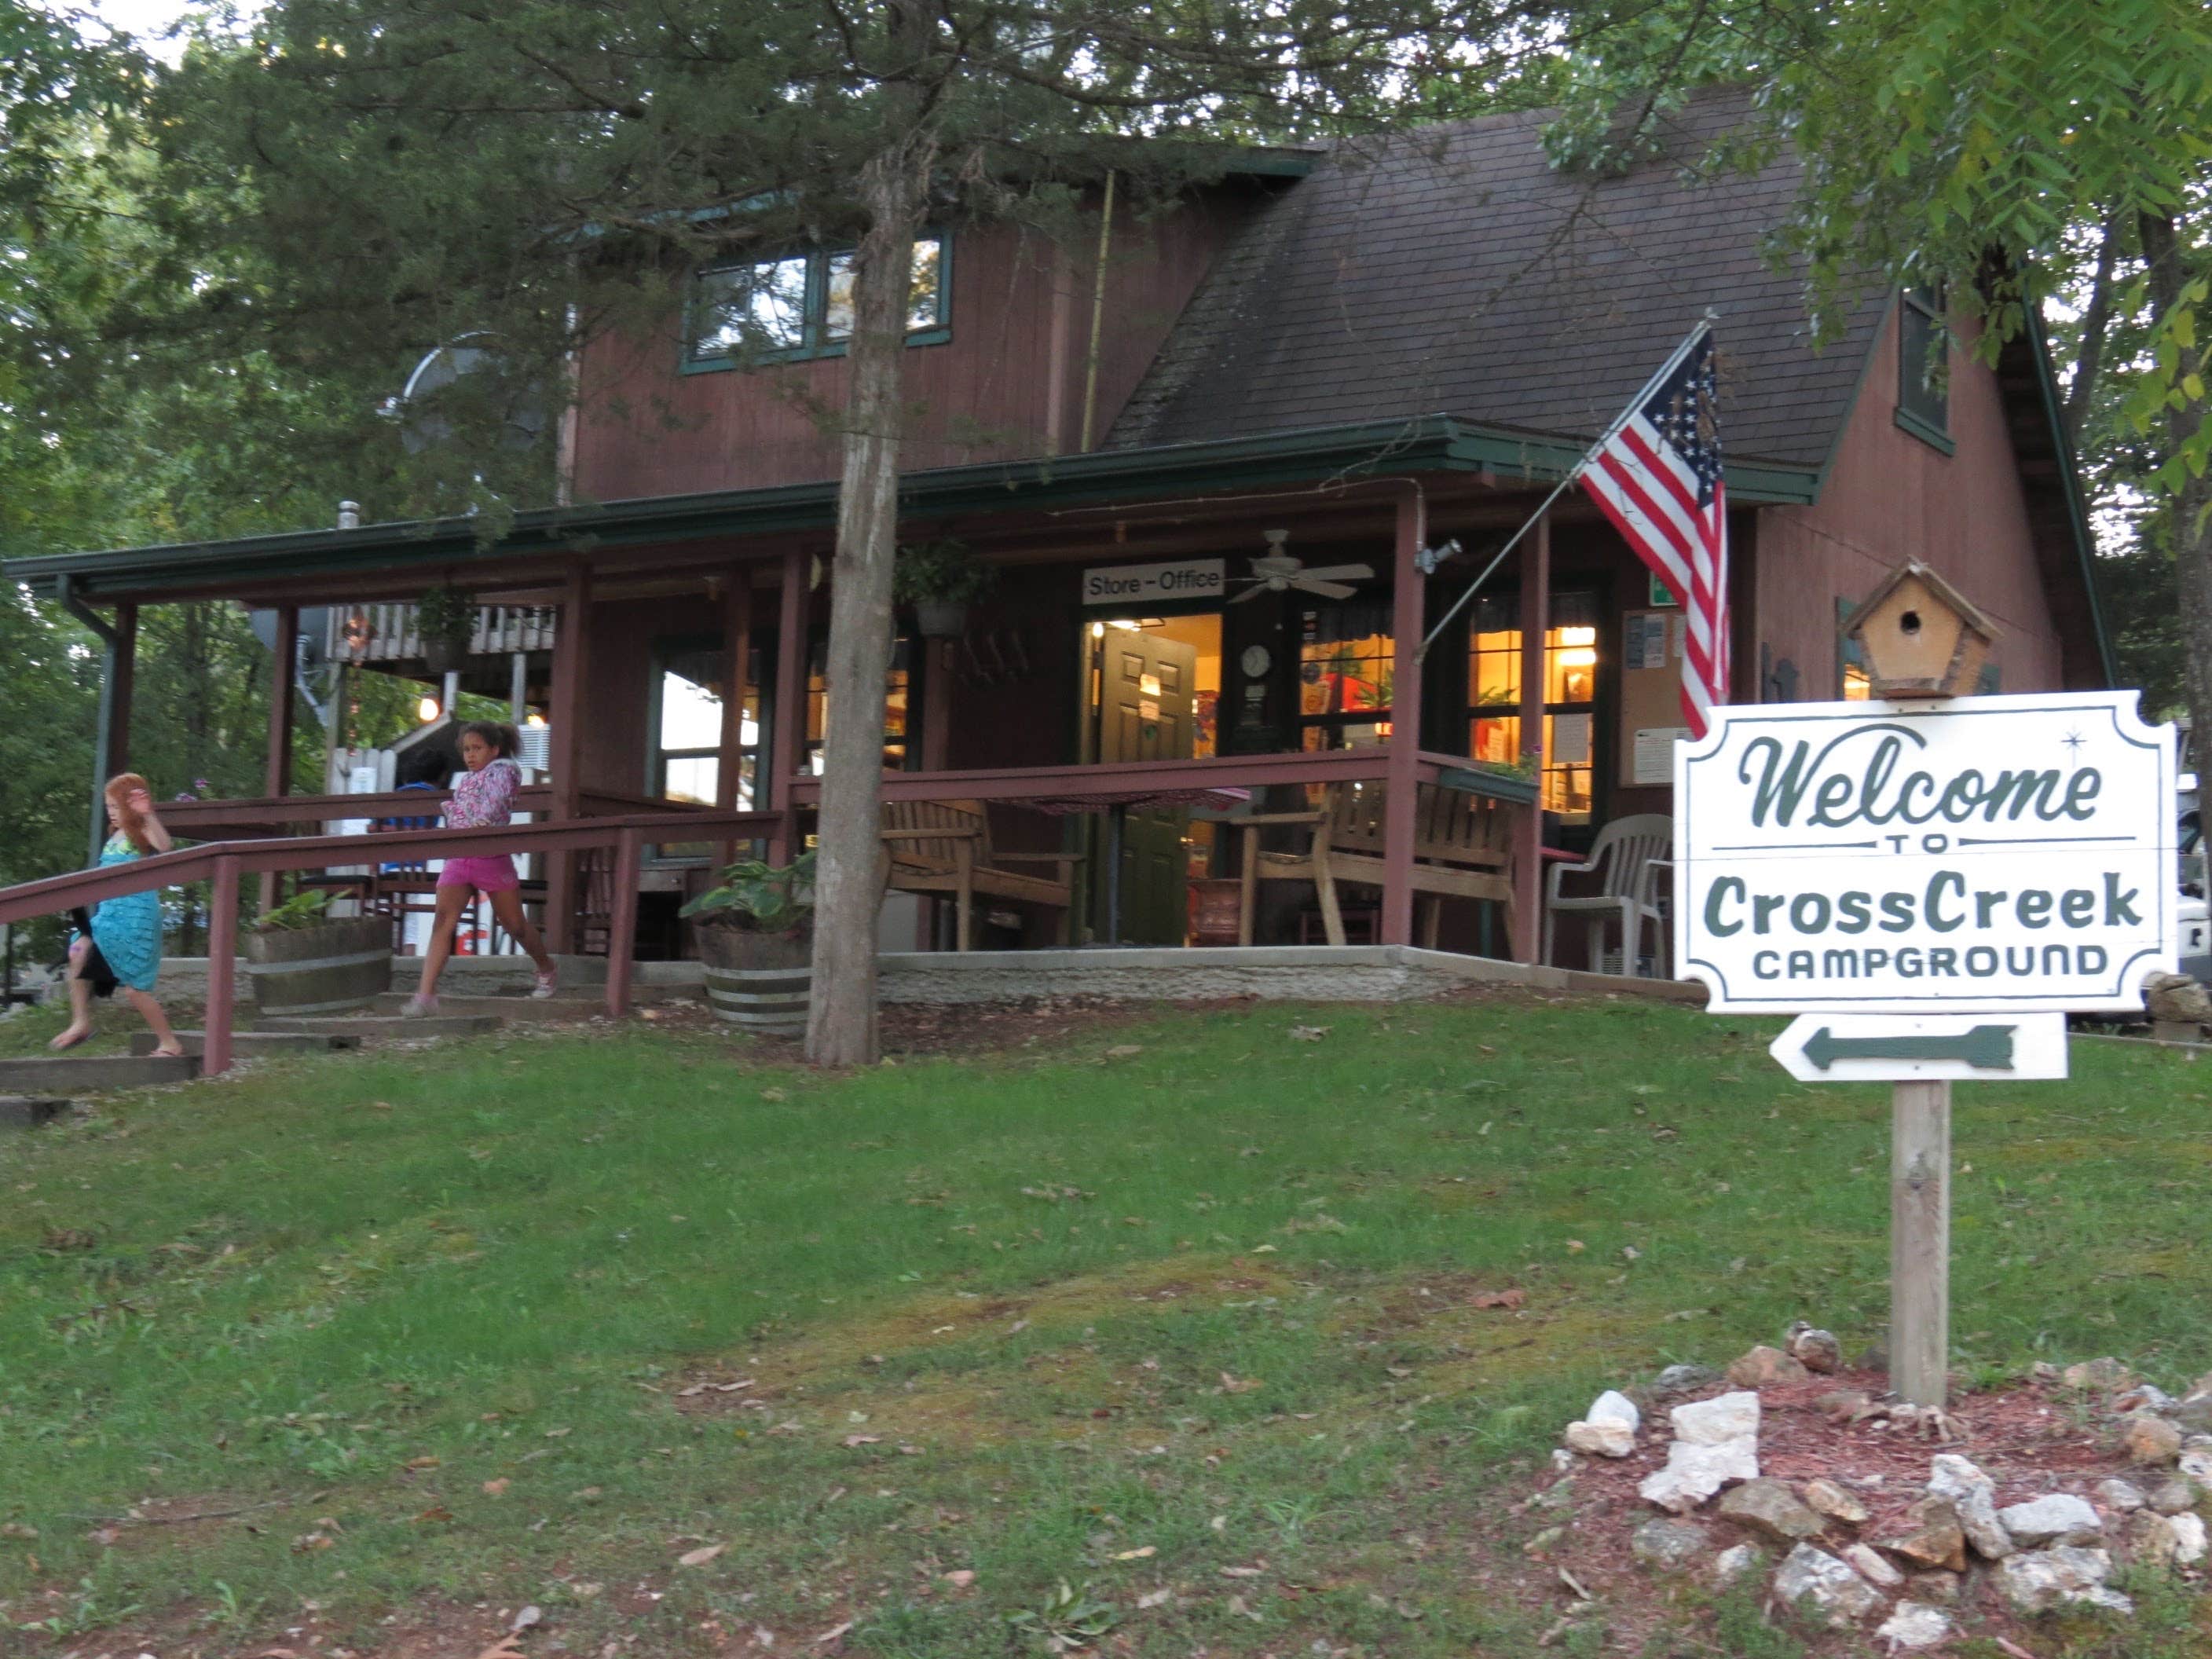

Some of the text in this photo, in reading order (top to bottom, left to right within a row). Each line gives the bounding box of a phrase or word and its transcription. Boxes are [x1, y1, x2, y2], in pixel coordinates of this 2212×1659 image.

[1738, 723, 2102, 829] Welcome
[1886, 833, 1948, 854] TO
[1753, 944, 2108, 980] CAMPGROUND
